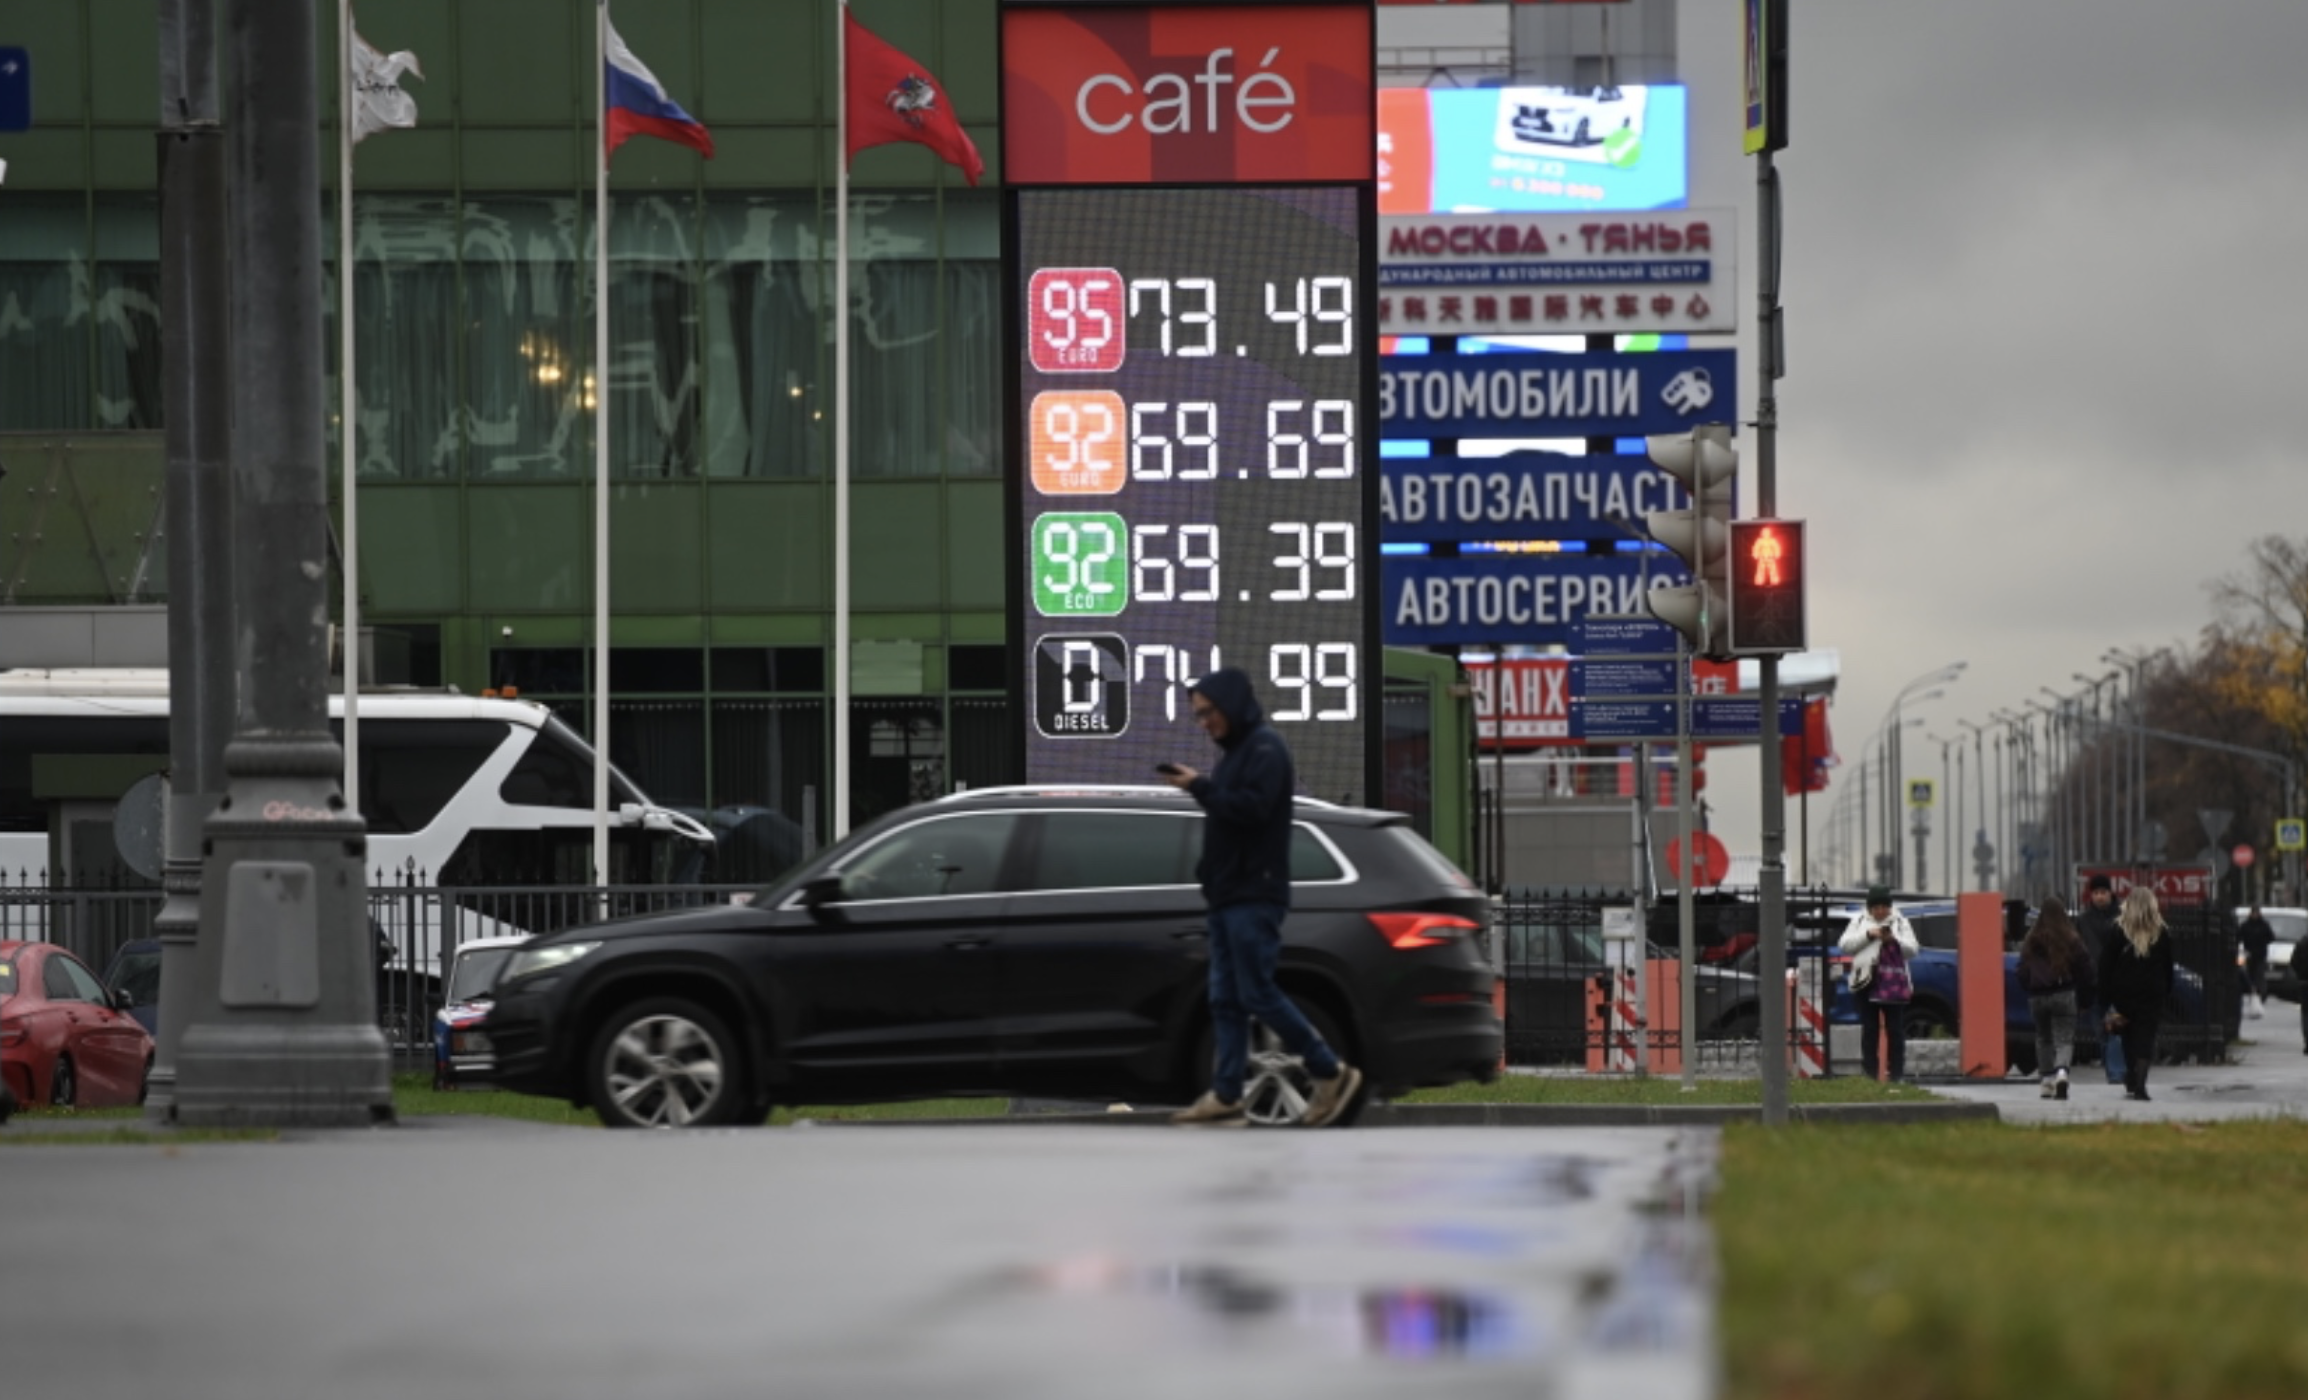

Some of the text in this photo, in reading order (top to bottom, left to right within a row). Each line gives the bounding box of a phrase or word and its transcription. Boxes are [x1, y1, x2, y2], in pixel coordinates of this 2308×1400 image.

[1076, 47, 1296, 135] café
[1387, 221, 1711, 256] МОСКВА ТЯНЬЯ
[1380, 263, 1703, 283] ДУНАРОДНЫЙ АВТОМОБИЛЬНЫЙ ЦЕНТР
[1042, 279, 1113, 349] 95
[1058, 347, 1098, 364] EURO
[1380, 368, 1640, 420] ВТОМОБИЛИ
[1045, 399, 1355, 480] 92 69.69
[1060, 471, 1100, 487] EURO
[1380, 472, 1693, 523] АВТОЗАПЧАСТ
[1043, 521, 1355, 601] 92 69.39
[1064, 593, 1094, 609] ECO
[1062, 640, 1357, 721] D 7499
[1054, 713, 1110, 731] DIESEL
